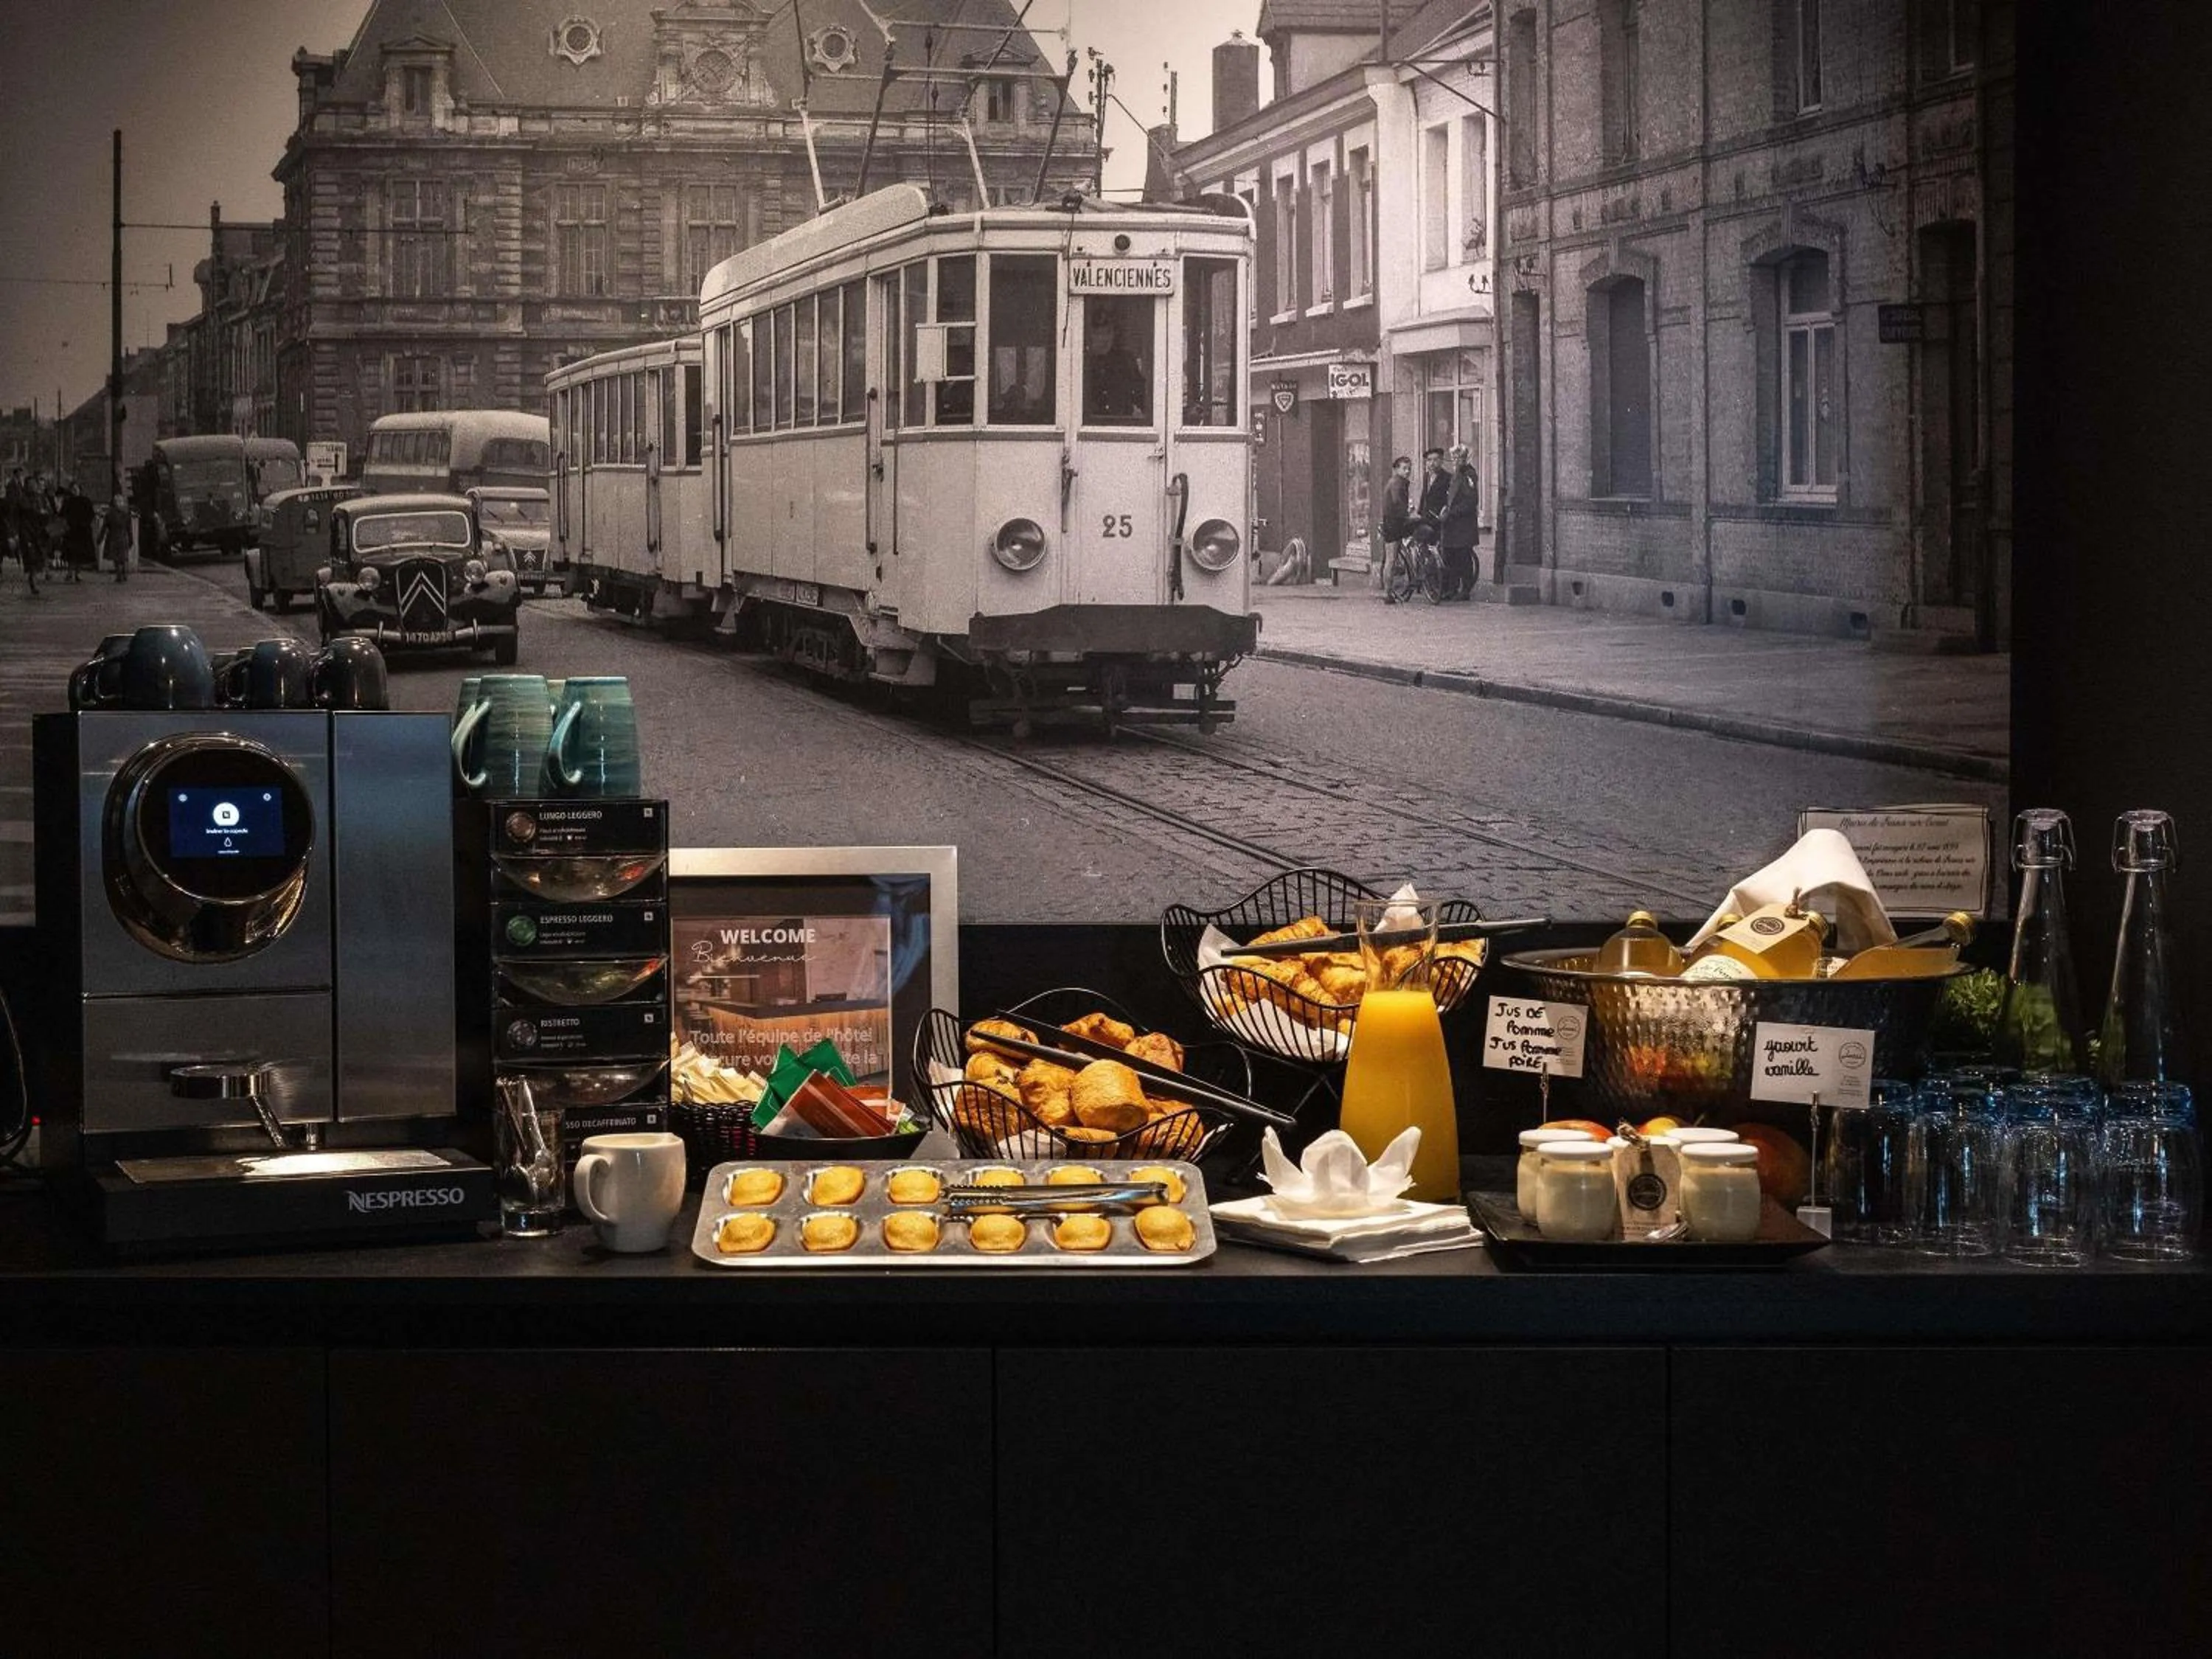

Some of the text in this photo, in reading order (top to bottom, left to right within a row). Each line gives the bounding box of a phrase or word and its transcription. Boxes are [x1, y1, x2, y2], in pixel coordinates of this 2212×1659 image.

[1073, 267, 1171, 288] VALENCIENNES
[1331, 372, 1369, 387] IGOL
[1102, 514, 1133, 538] 25
[539, 810, 602, 821] LUNGO LEGGERO
[540, 914, 613, 924] ESPRESSO LEGGERO
[720, 928, 816, 945] WELCOME
[540, 1018, 580, 1027] RISTRETTO
[690, 1029, 735, 1044] Toute
[739, 1029, 800, 1048] l'équipe
[804, 1027, 822, 1043] de
[864, 1048, 878, 1065] la
[1764, 1035, 1818, 1062] yaourt
[1764, 1057, 1820, 1077] vanille
[582, 1116, 636, 1127] DECAFFEINATO
[344, 1188, 465, 1214] NESPRESSO
